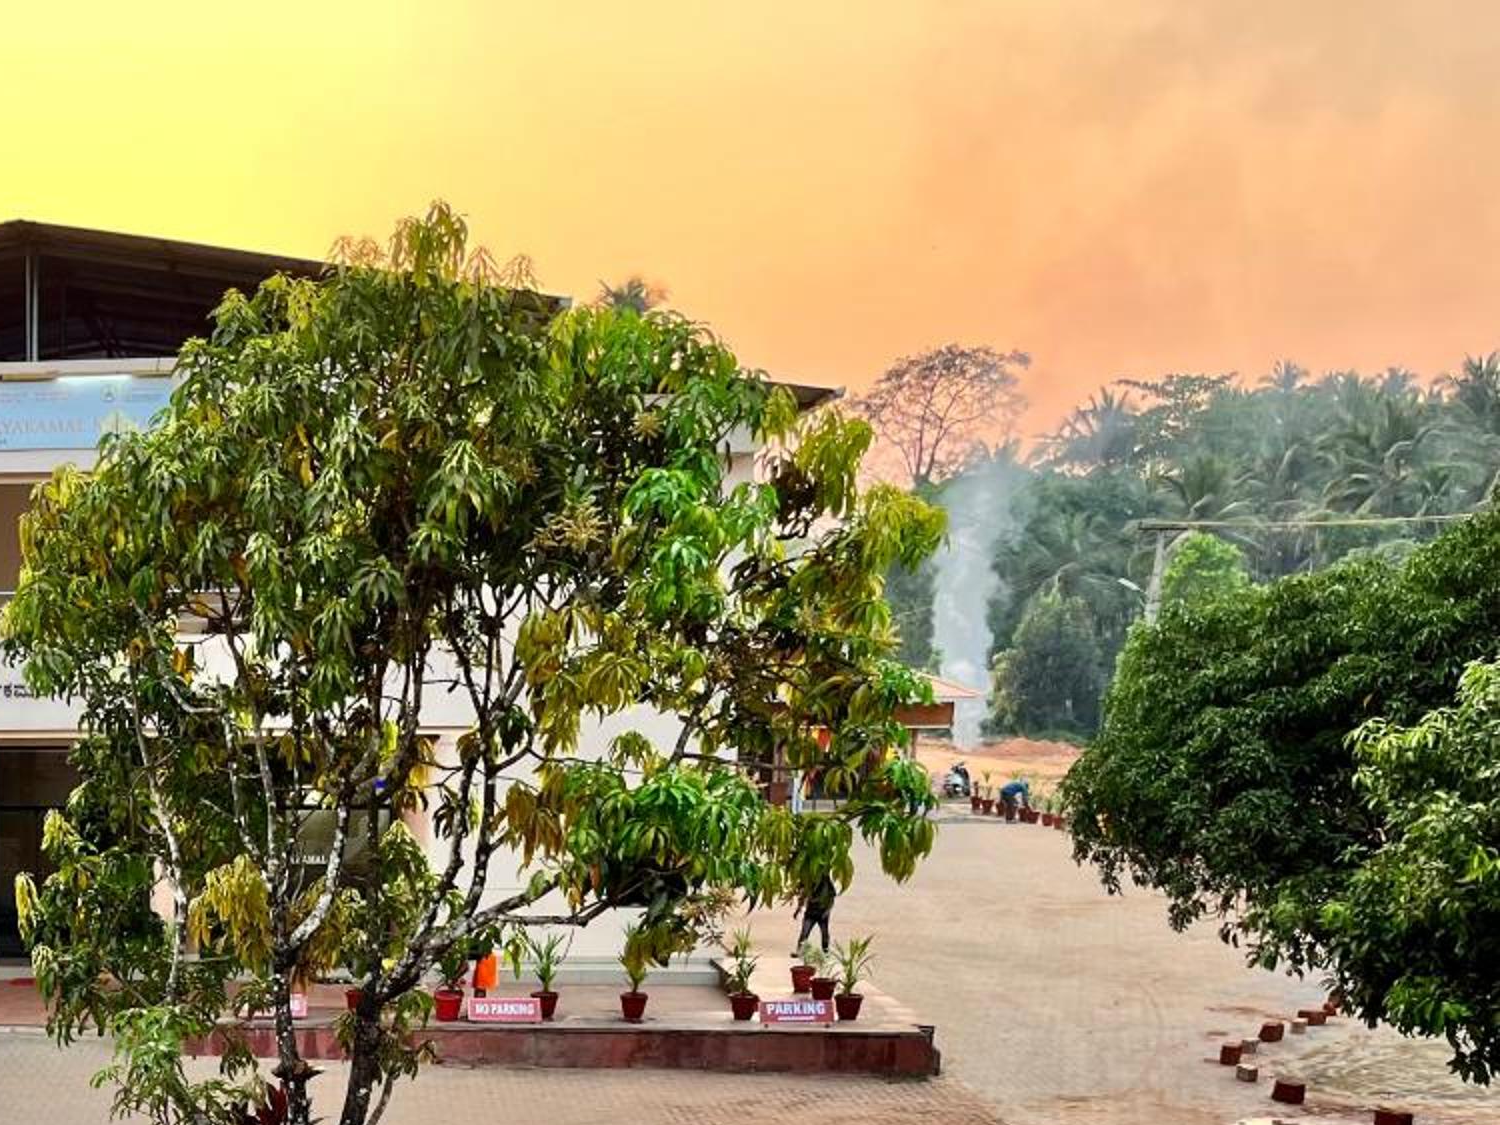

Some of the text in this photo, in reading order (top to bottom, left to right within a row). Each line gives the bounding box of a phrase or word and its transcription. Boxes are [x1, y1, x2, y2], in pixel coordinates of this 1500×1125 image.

[475, 1003, 534, 1015] NO PARKING
[765, 1002, 826, 1015] PARKING
